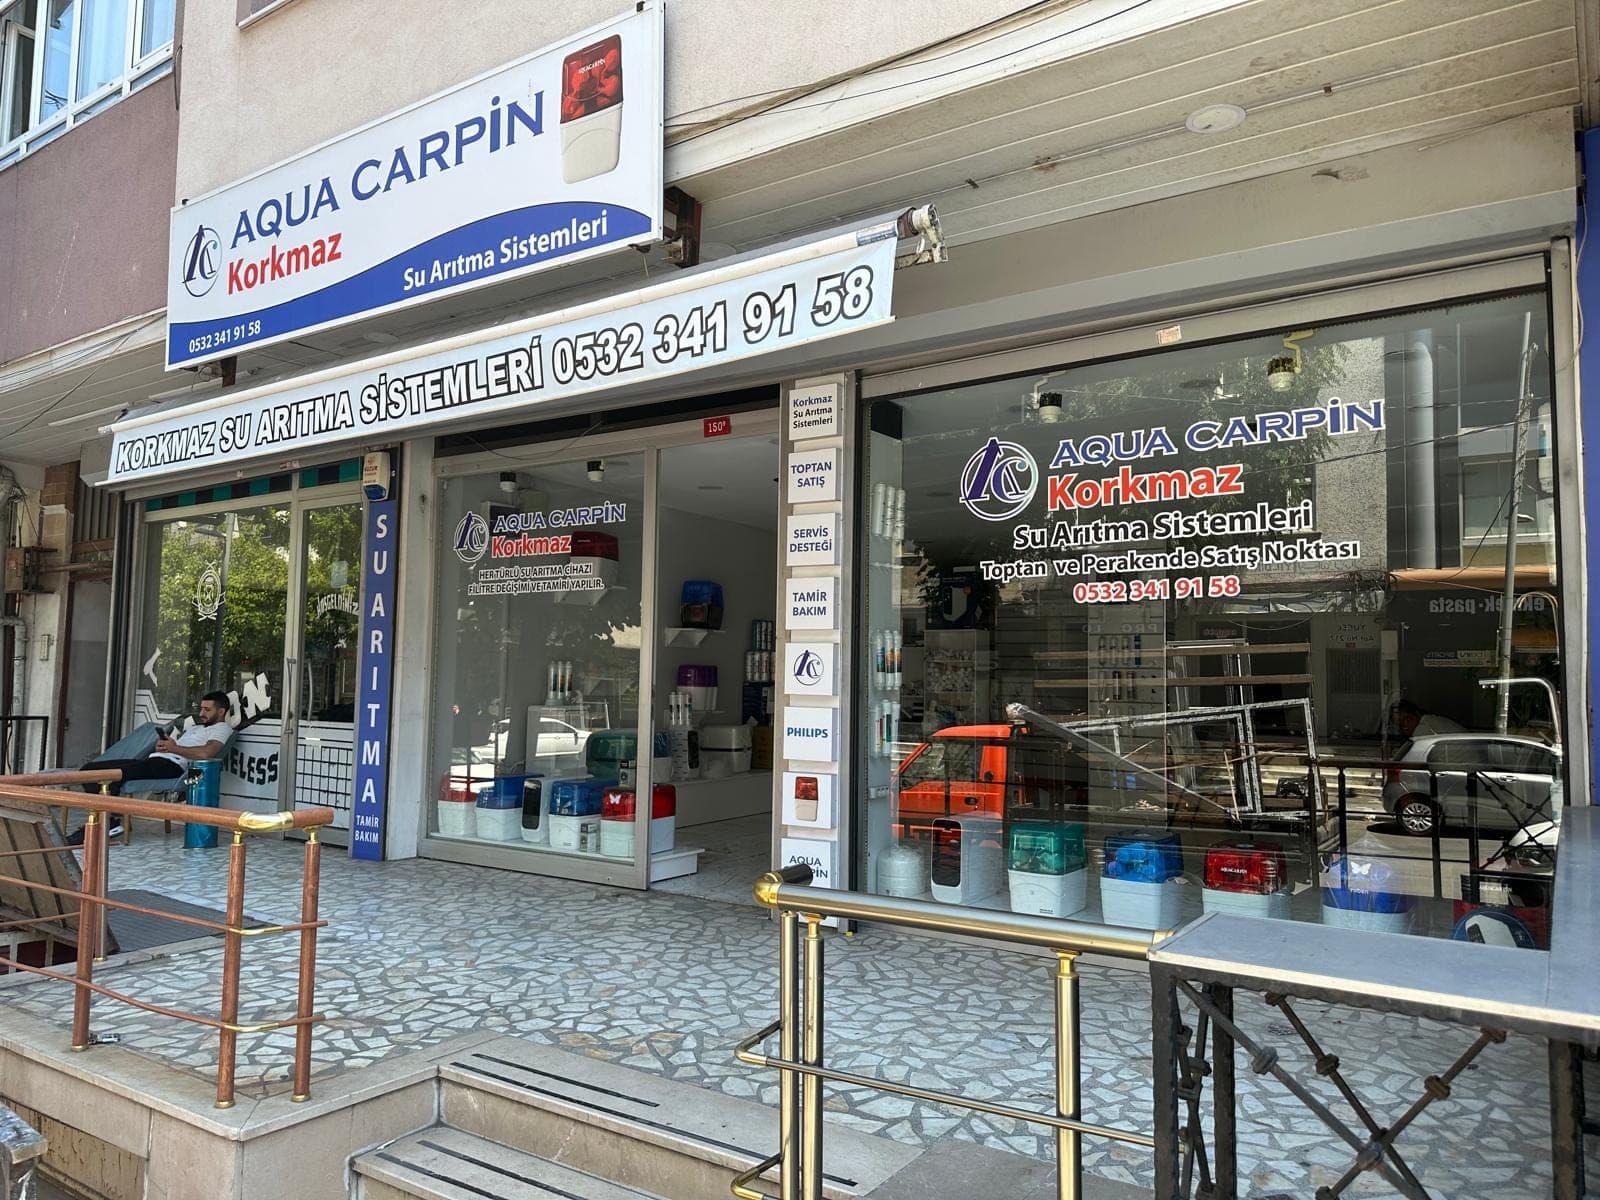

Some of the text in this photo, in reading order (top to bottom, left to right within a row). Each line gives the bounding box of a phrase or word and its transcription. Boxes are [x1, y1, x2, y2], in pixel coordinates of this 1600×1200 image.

[230, 90, 544, 249] AQUA CARPİN
[403, 210, 608, 291] Su Arıtma Sistemleri
[227, 232, 342, 296] Korkmaz
[189, 320, 261, 354] 0532 341 91 58
[115, 265, 874, 474] KORKMAZ SU ARITMA SİSTEMLERİ 0532 341 91 58
[793, 395, 833, 408] Korkmaz
[793, 406, 833, 419] Su Arıtma
[793, 415, 833, 430] Sistemleri
[1049, 397, 1386, 469] AQUA CARPİN
[791, 461, 832, 474] TOPTAN
[797, 475, 825, 488] SATIŞ
[1047, 463, 1245, 513] Korkmaz
[493, 501, 627, 534] AQUA CARPİN
[1013, 500, 1313, 550] Su Arıtma Sistemleri
[794, 525, 828, 539] SERVİS
[491, 533, 572, 559] Korkmaz
[790, 538, 832, 553] DESTEĞİ
[980, 539, 1360, 581] Toptan ve Perakende Satış Noktası
[479, 562, 592, 581] HER TÜRLÜ SU ARITMA CİHAZI
[530, 580, 541, 592] VE
[541, 578, 569, 591] TAMİRİ
[1073, 576, 1240, 604] 0532 341 91 58
[793, 589, 827, 602] TAMİR
[792, 606, 827, 617] BAKIM
[361, 513, 388, 804] SU ARITMA
[787, 727, 828, 738] PHILIPS
[356, 814, 379, 828] TAMİR
[354, 830, 379, 844] BAKIM
[789, 855, 822, 867] AQUA
